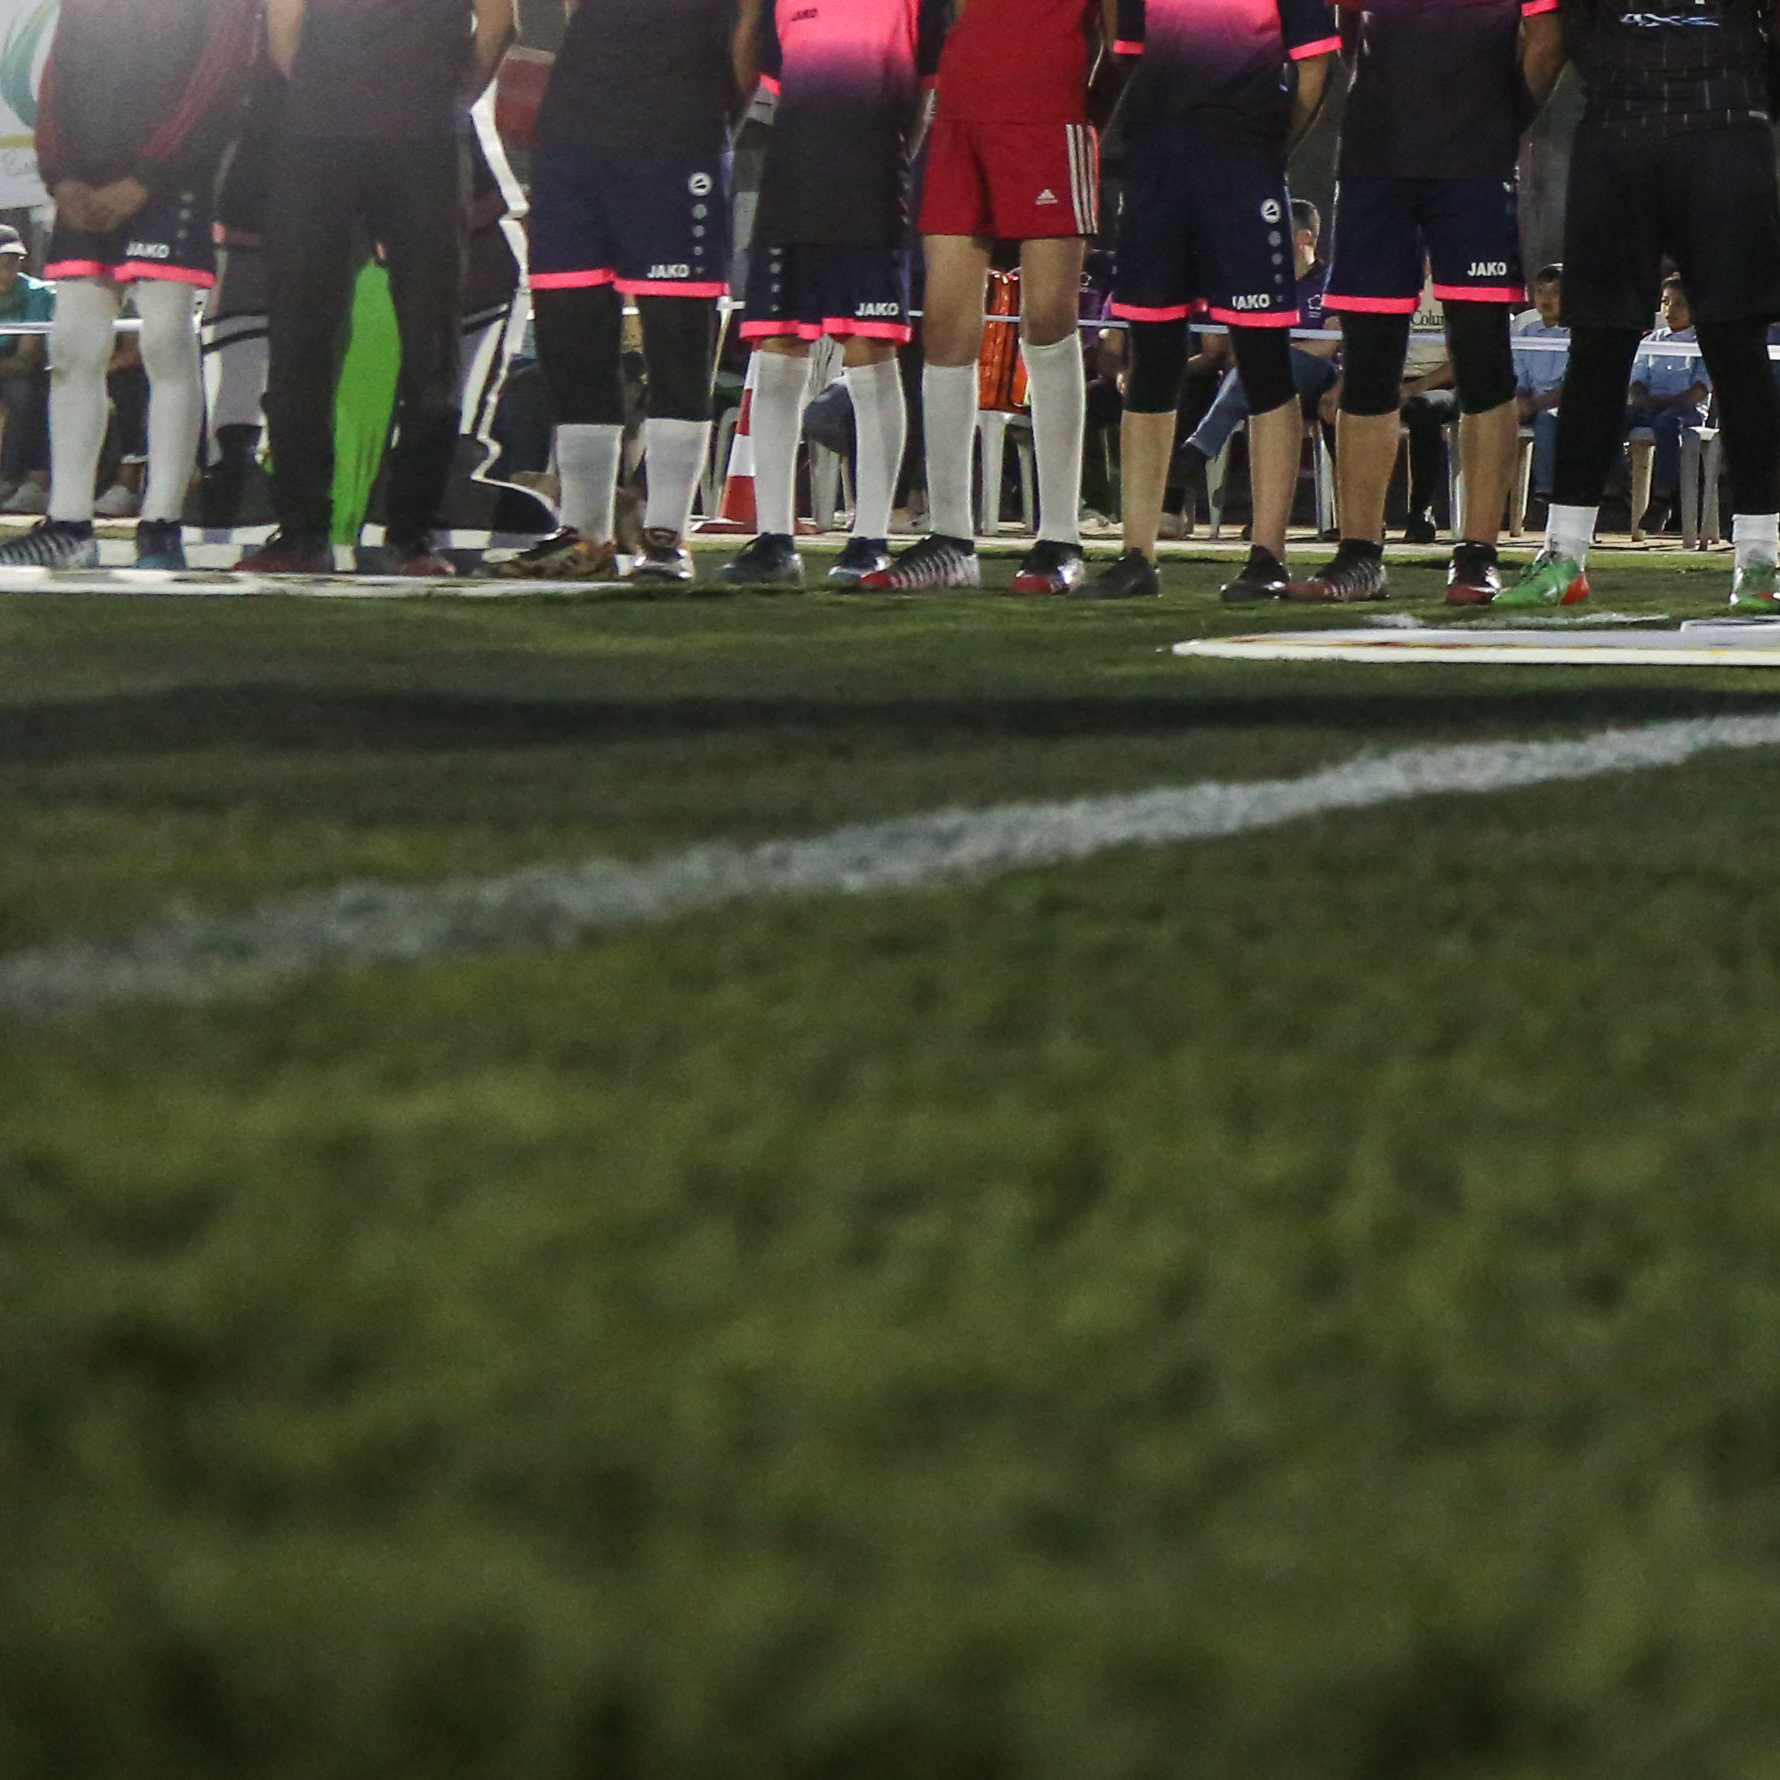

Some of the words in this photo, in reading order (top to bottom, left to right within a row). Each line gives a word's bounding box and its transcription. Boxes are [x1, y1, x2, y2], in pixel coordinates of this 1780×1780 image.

[126, 241, 170, 257] JAKO
[647, 263, 690, 278] JAKO
[1467, 261, 1507, 276] JAKO
[855, 302, 900, 316] JAKO
